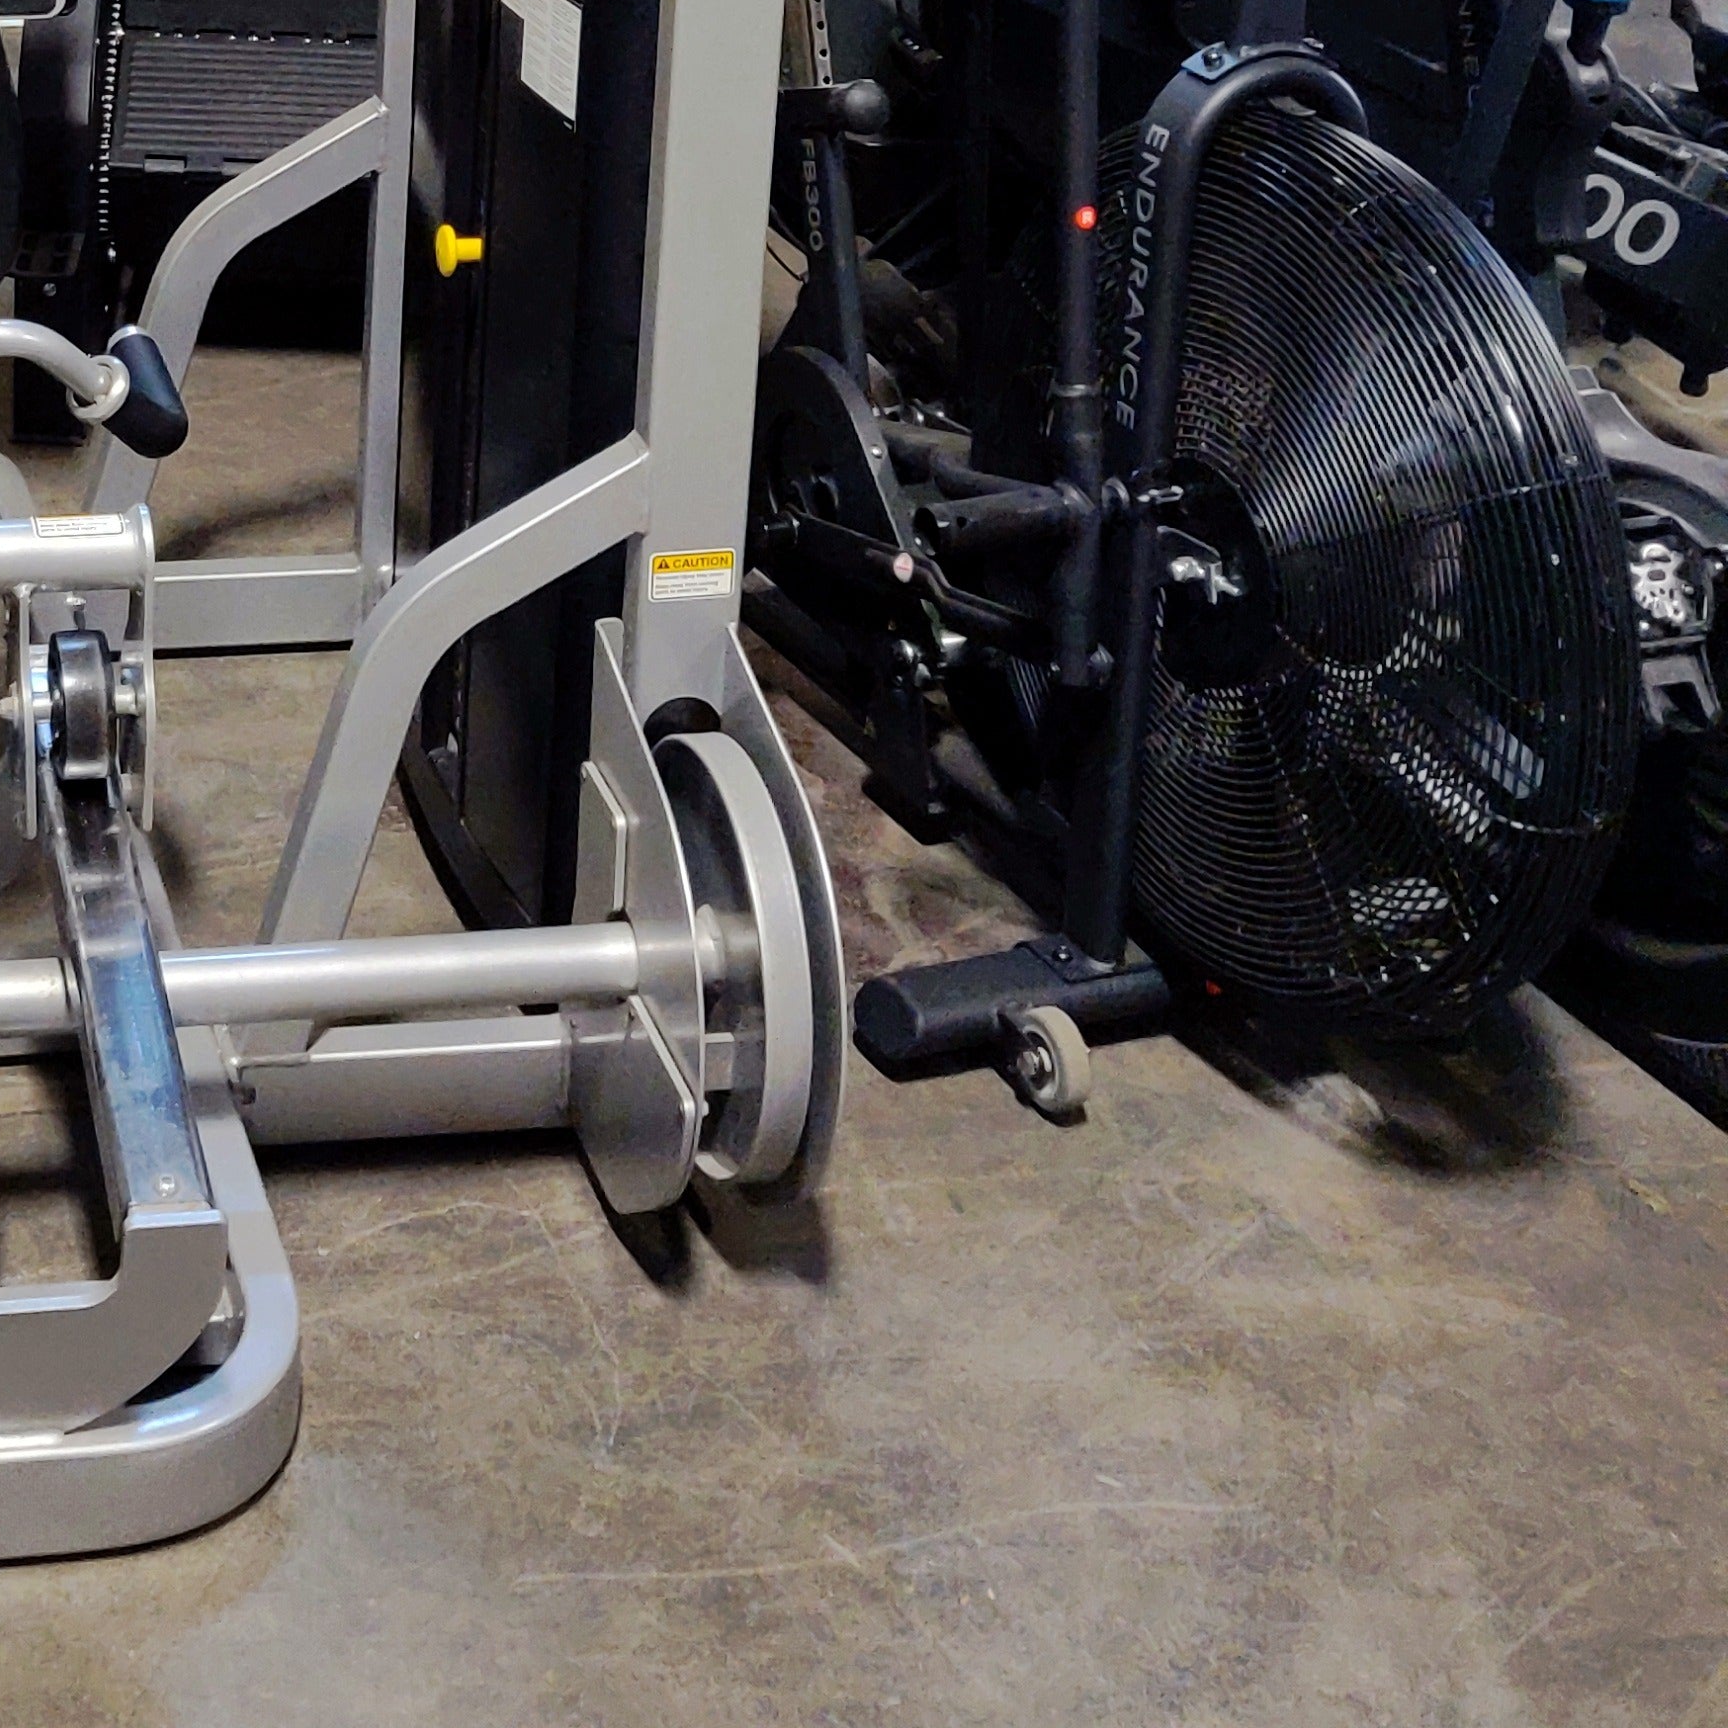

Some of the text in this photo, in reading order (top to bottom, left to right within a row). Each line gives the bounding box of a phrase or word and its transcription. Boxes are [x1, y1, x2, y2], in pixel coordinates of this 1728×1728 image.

[801, 138, 823, 252] FB300
[1116, 123, 1170, 431] ENDURANCE
[673, 555, 729, 569] CAUTION
